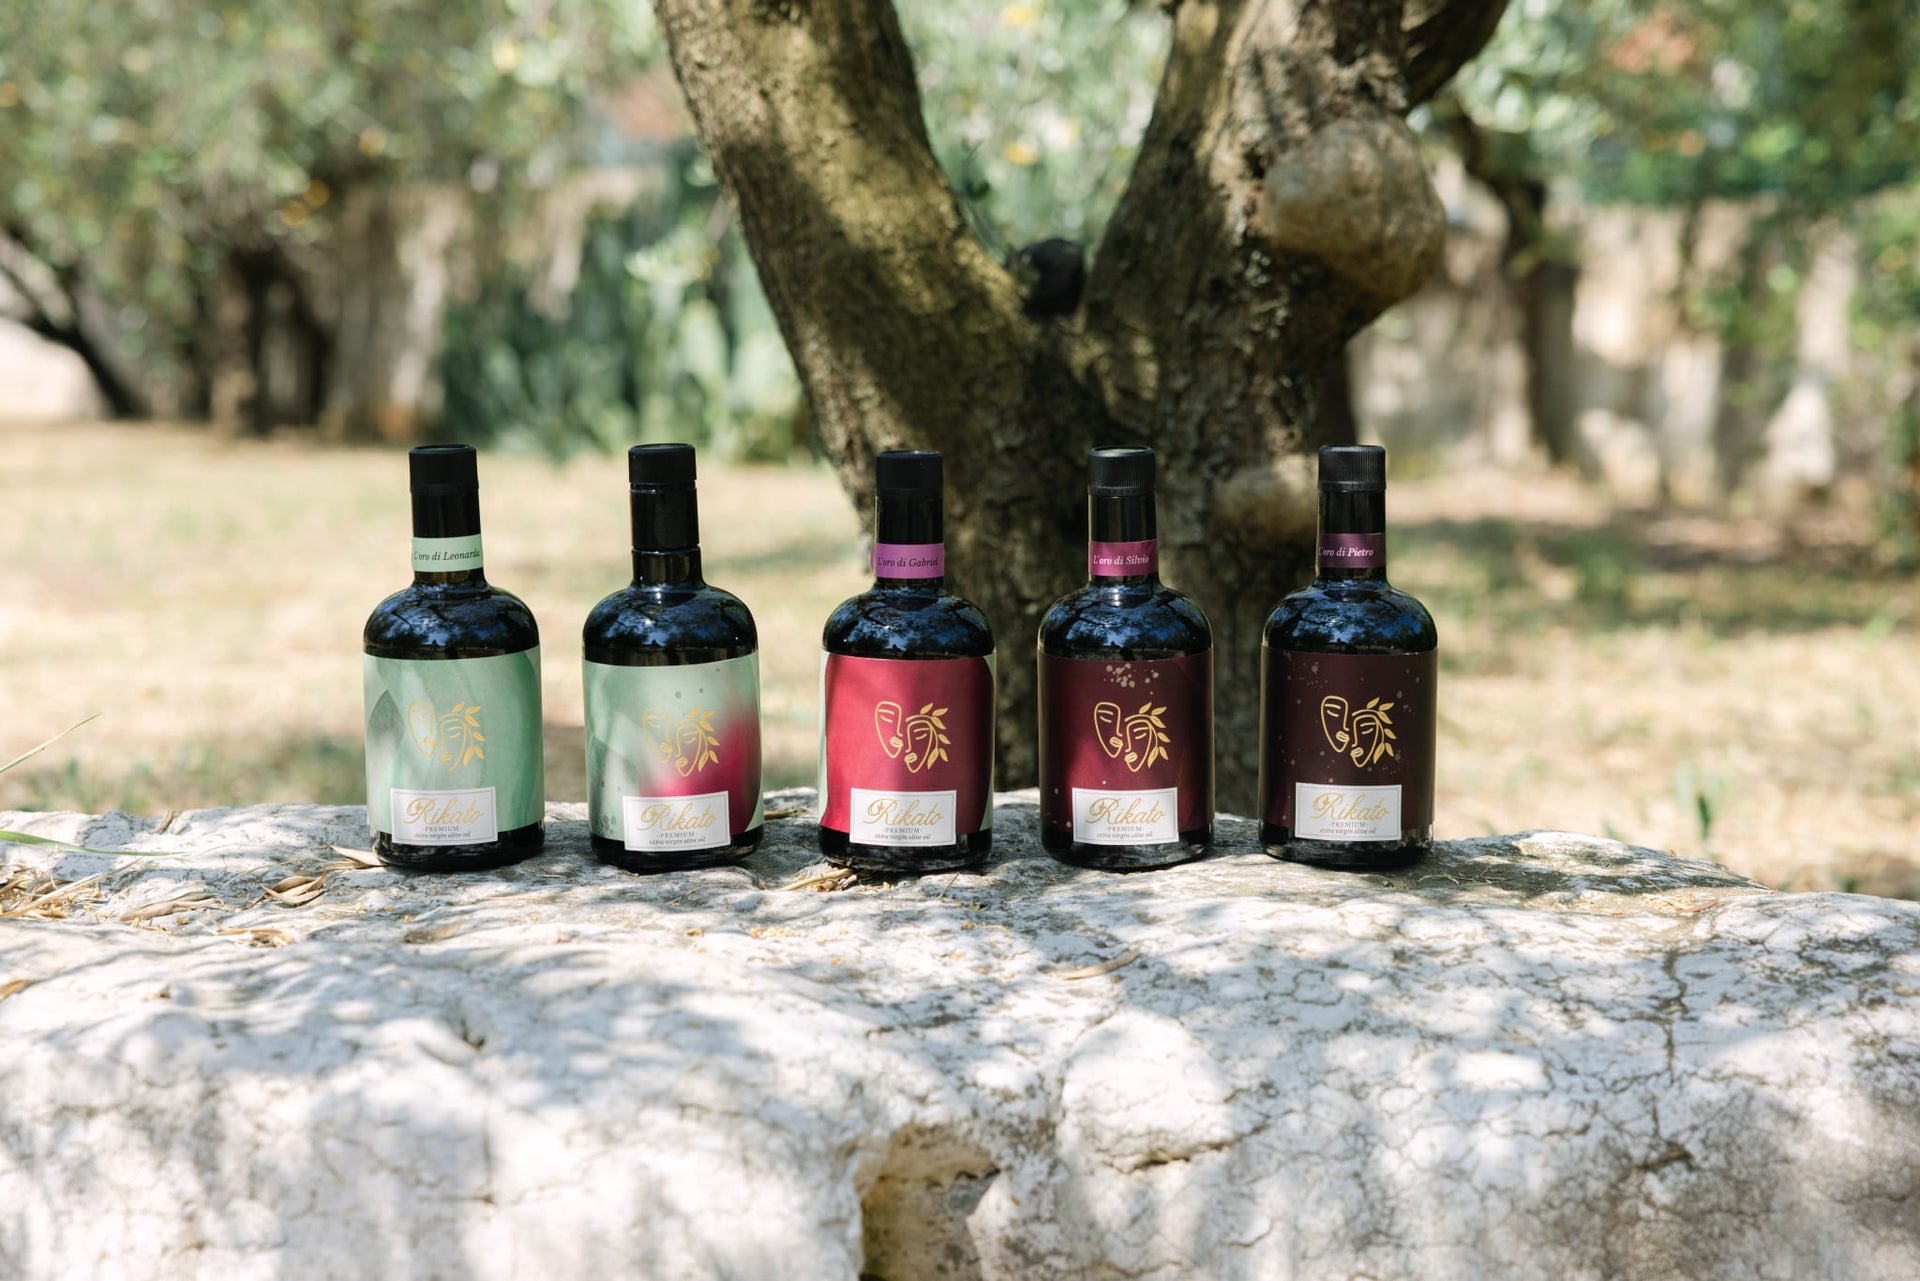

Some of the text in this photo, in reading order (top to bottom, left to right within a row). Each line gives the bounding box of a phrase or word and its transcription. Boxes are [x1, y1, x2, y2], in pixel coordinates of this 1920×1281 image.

[431, 551, 441, 561] di
[896, 557, 907, 568] di
[1093, 554, 1150, 566] L'oro di Silvio
[1336, 547, 1346, 557] di
[1347, 547, 1374, 557] Pietro
[403, 796, 484, 826] Rikato
[635, 801, 718, 831] Rikato
[863, 798, 945, 826] Rikato
[1086, 797, 1167, 825] Rikato
[1307, 792, 1391, 821] Rikato
